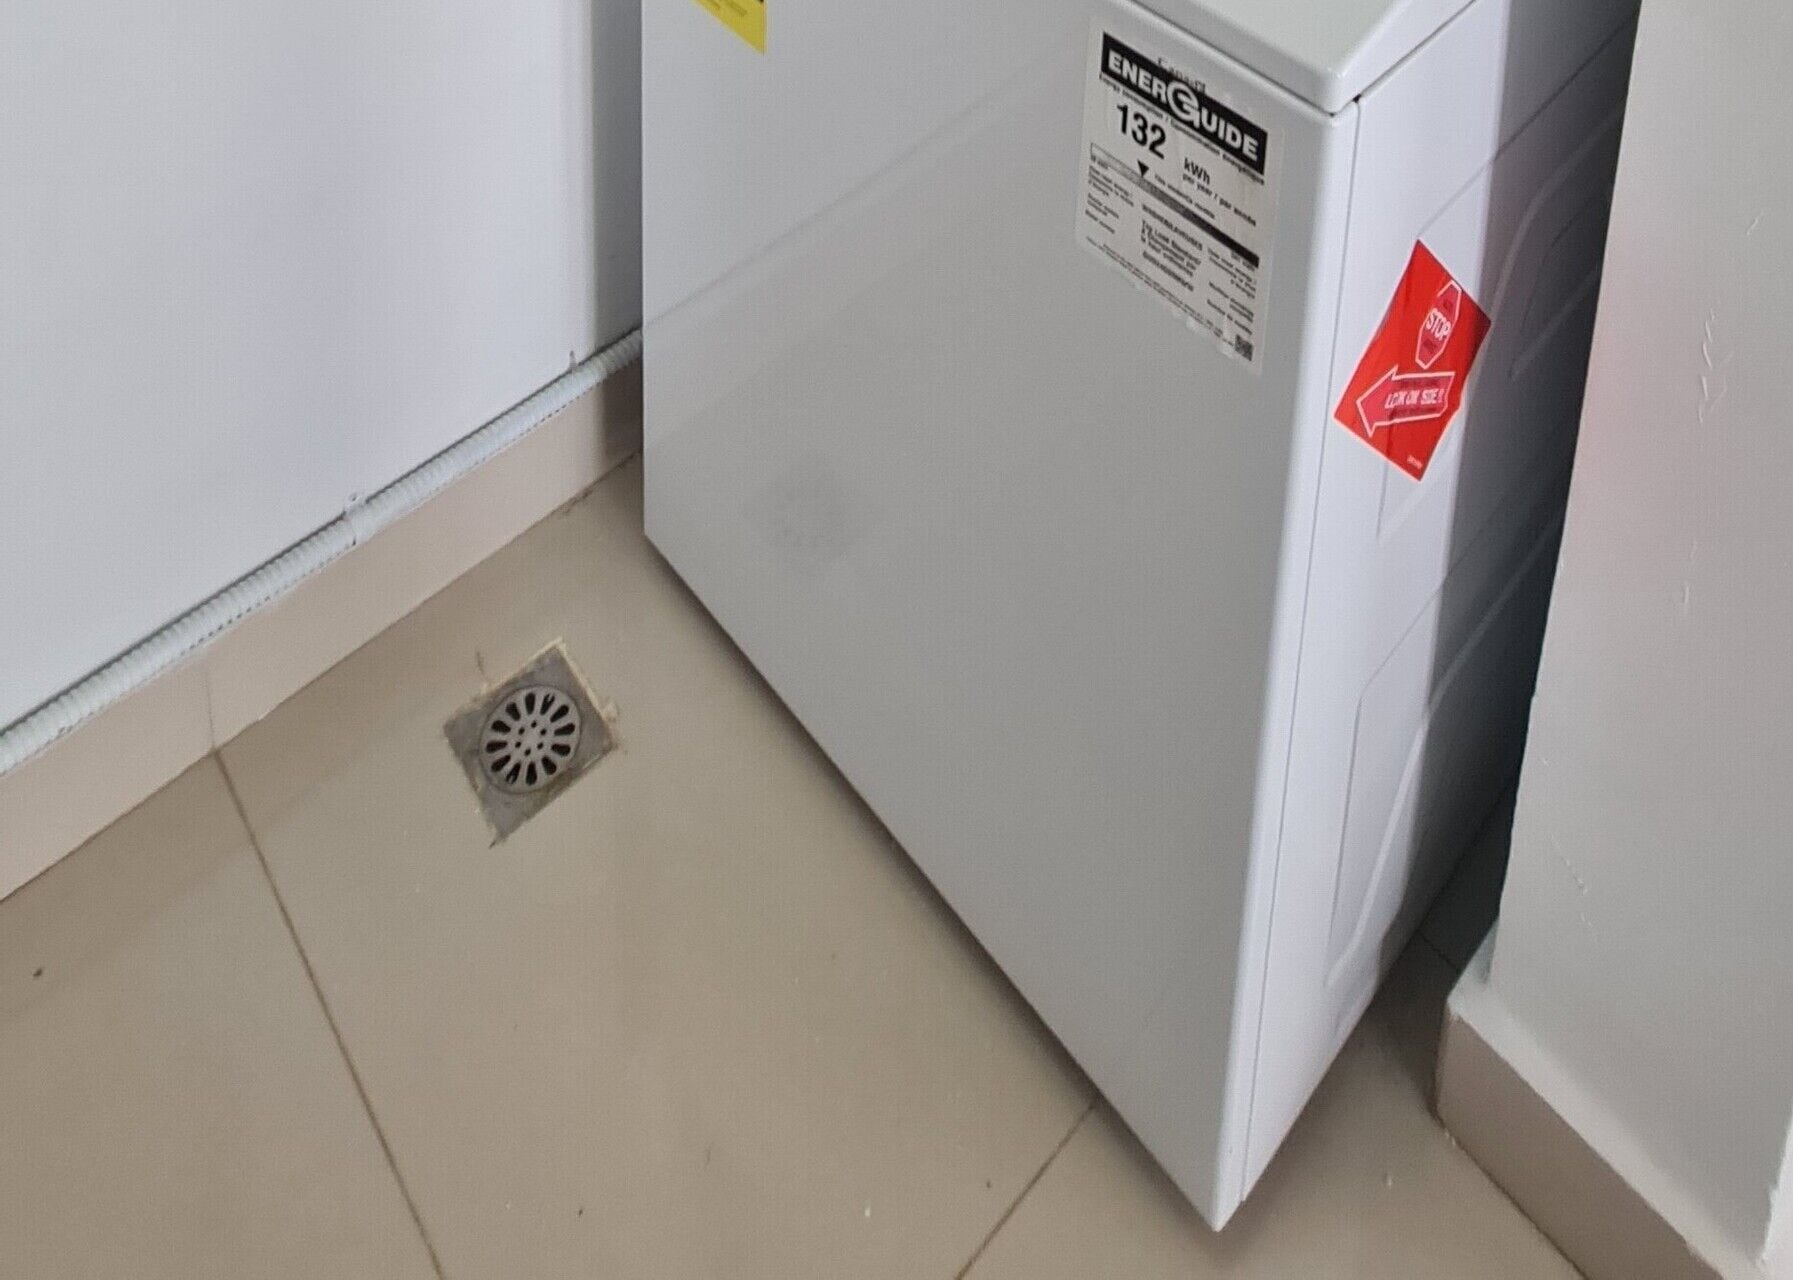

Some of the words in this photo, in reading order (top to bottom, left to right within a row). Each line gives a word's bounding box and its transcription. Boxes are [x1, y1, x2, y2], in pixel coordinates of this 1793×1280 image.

[1107, 49, 1259, 162] ENERGUIDE
[1117, 103, 1166, 159] 132
[1184, 157, 1210, 184] kWh
[1425, 307, 1452, 342] STOP
